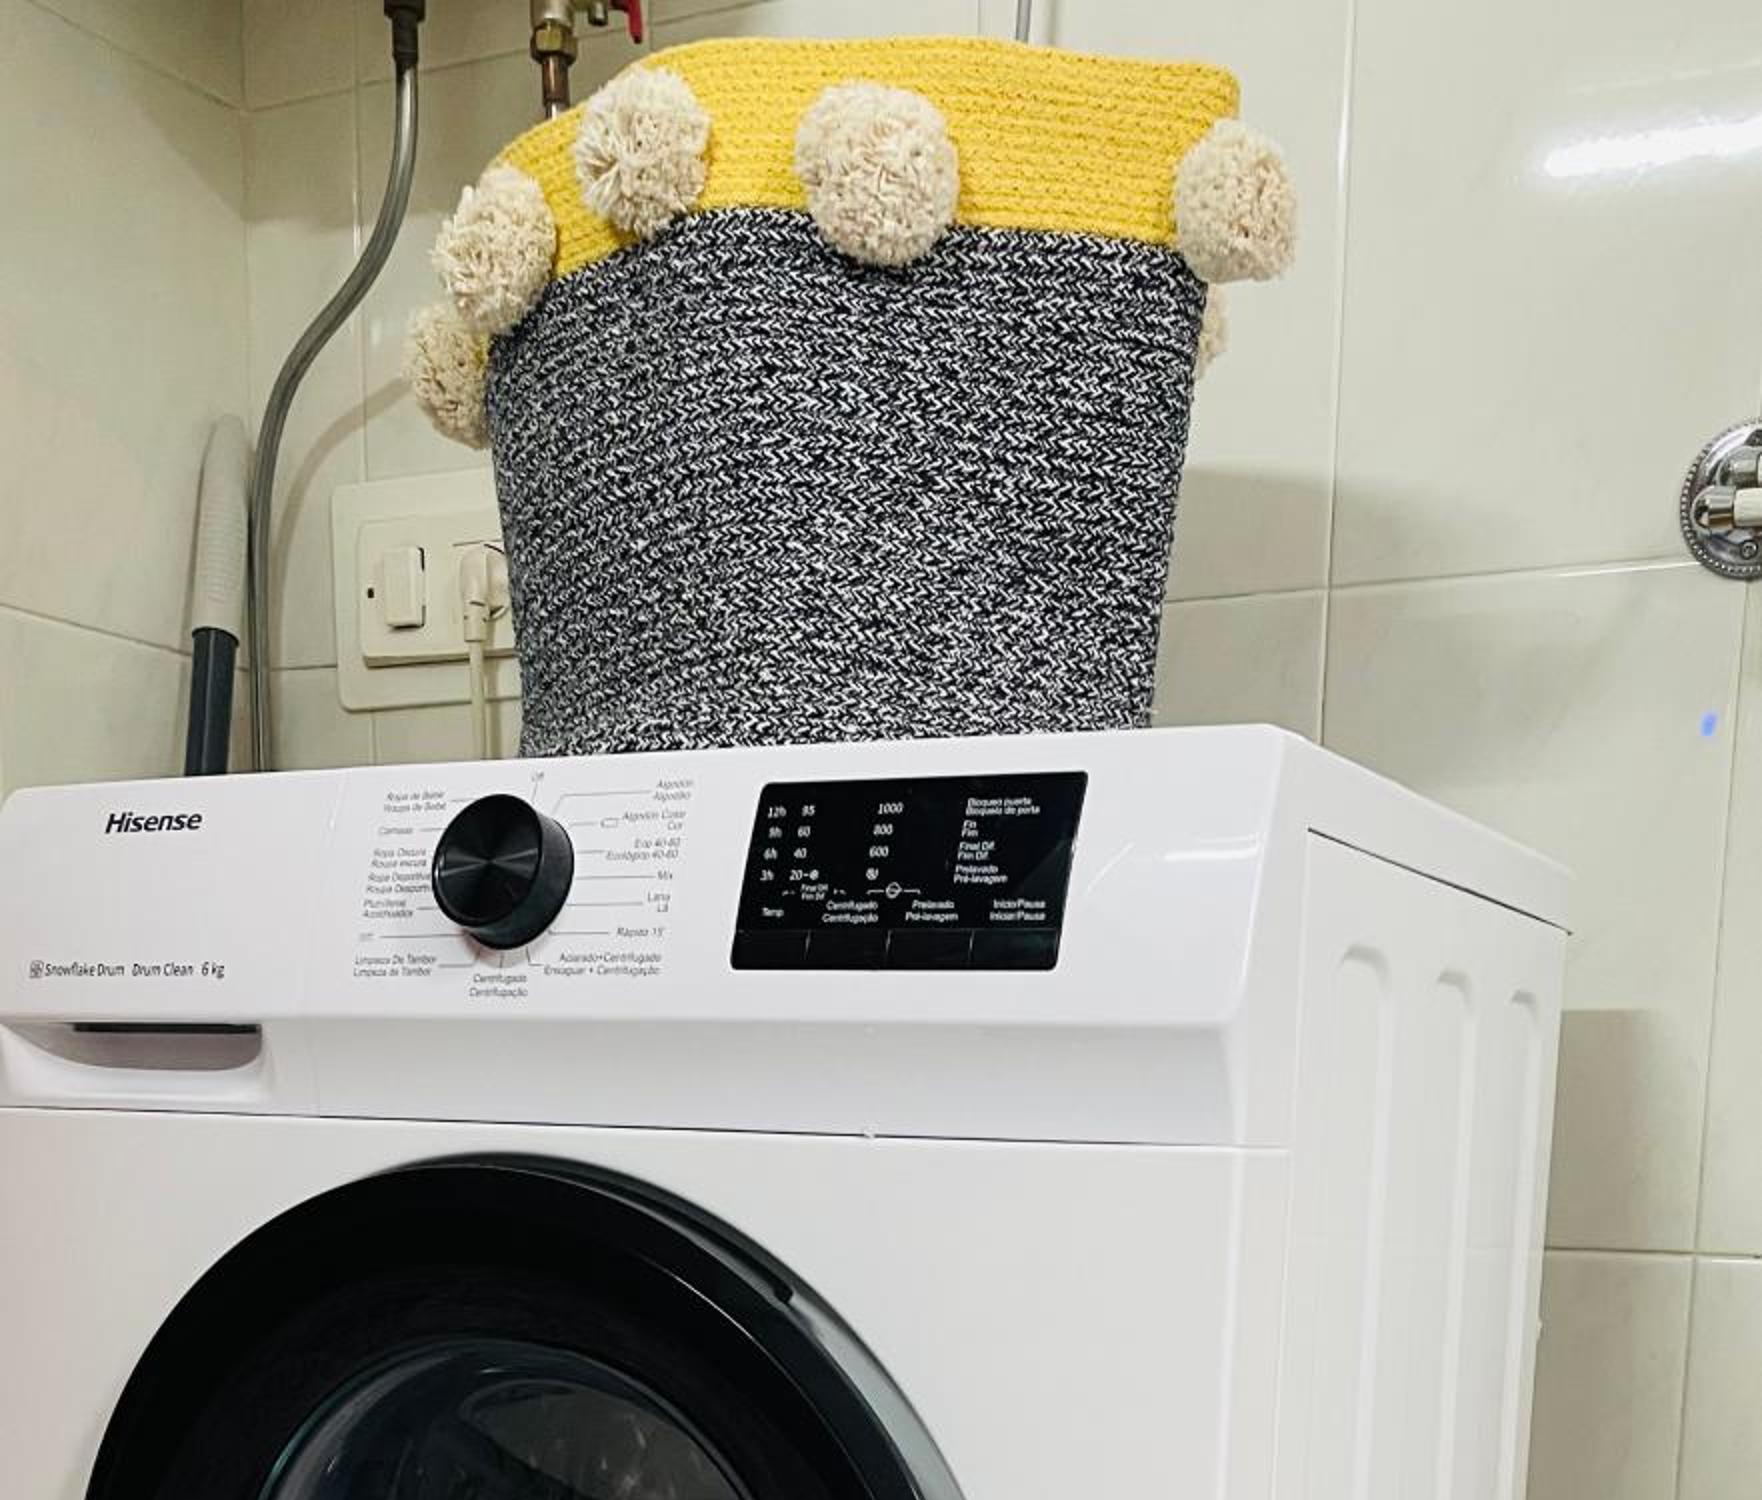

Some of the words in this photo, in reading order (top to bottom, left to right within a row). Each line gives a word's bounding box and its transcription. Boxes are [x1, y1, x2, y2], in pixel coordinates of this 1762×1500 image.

[767, 806, 787, 818] 12h
[877, 801, 905, 815] 1000
[105, 811, 203, 834] Hisense
[797, 825, 811, 838] 60
[873, 823, 893, 836] 800
[763, 848, 778, 861] 6h
[793, 848, 807, 859] 40
[869, 846, 889, 859] 600
[759, 869, 775, 882] 3h
[826, 900, 879, 912] Centrifugado
[45, 961, 96, 977] Snowflake
[98, 963, 126, 977] Drum
[132, 963, 162, 977] Drum
[163, 961, 194, 977] Clean
[201, 961, 209, 977] 6
[211, 962, 225, 979] kg
